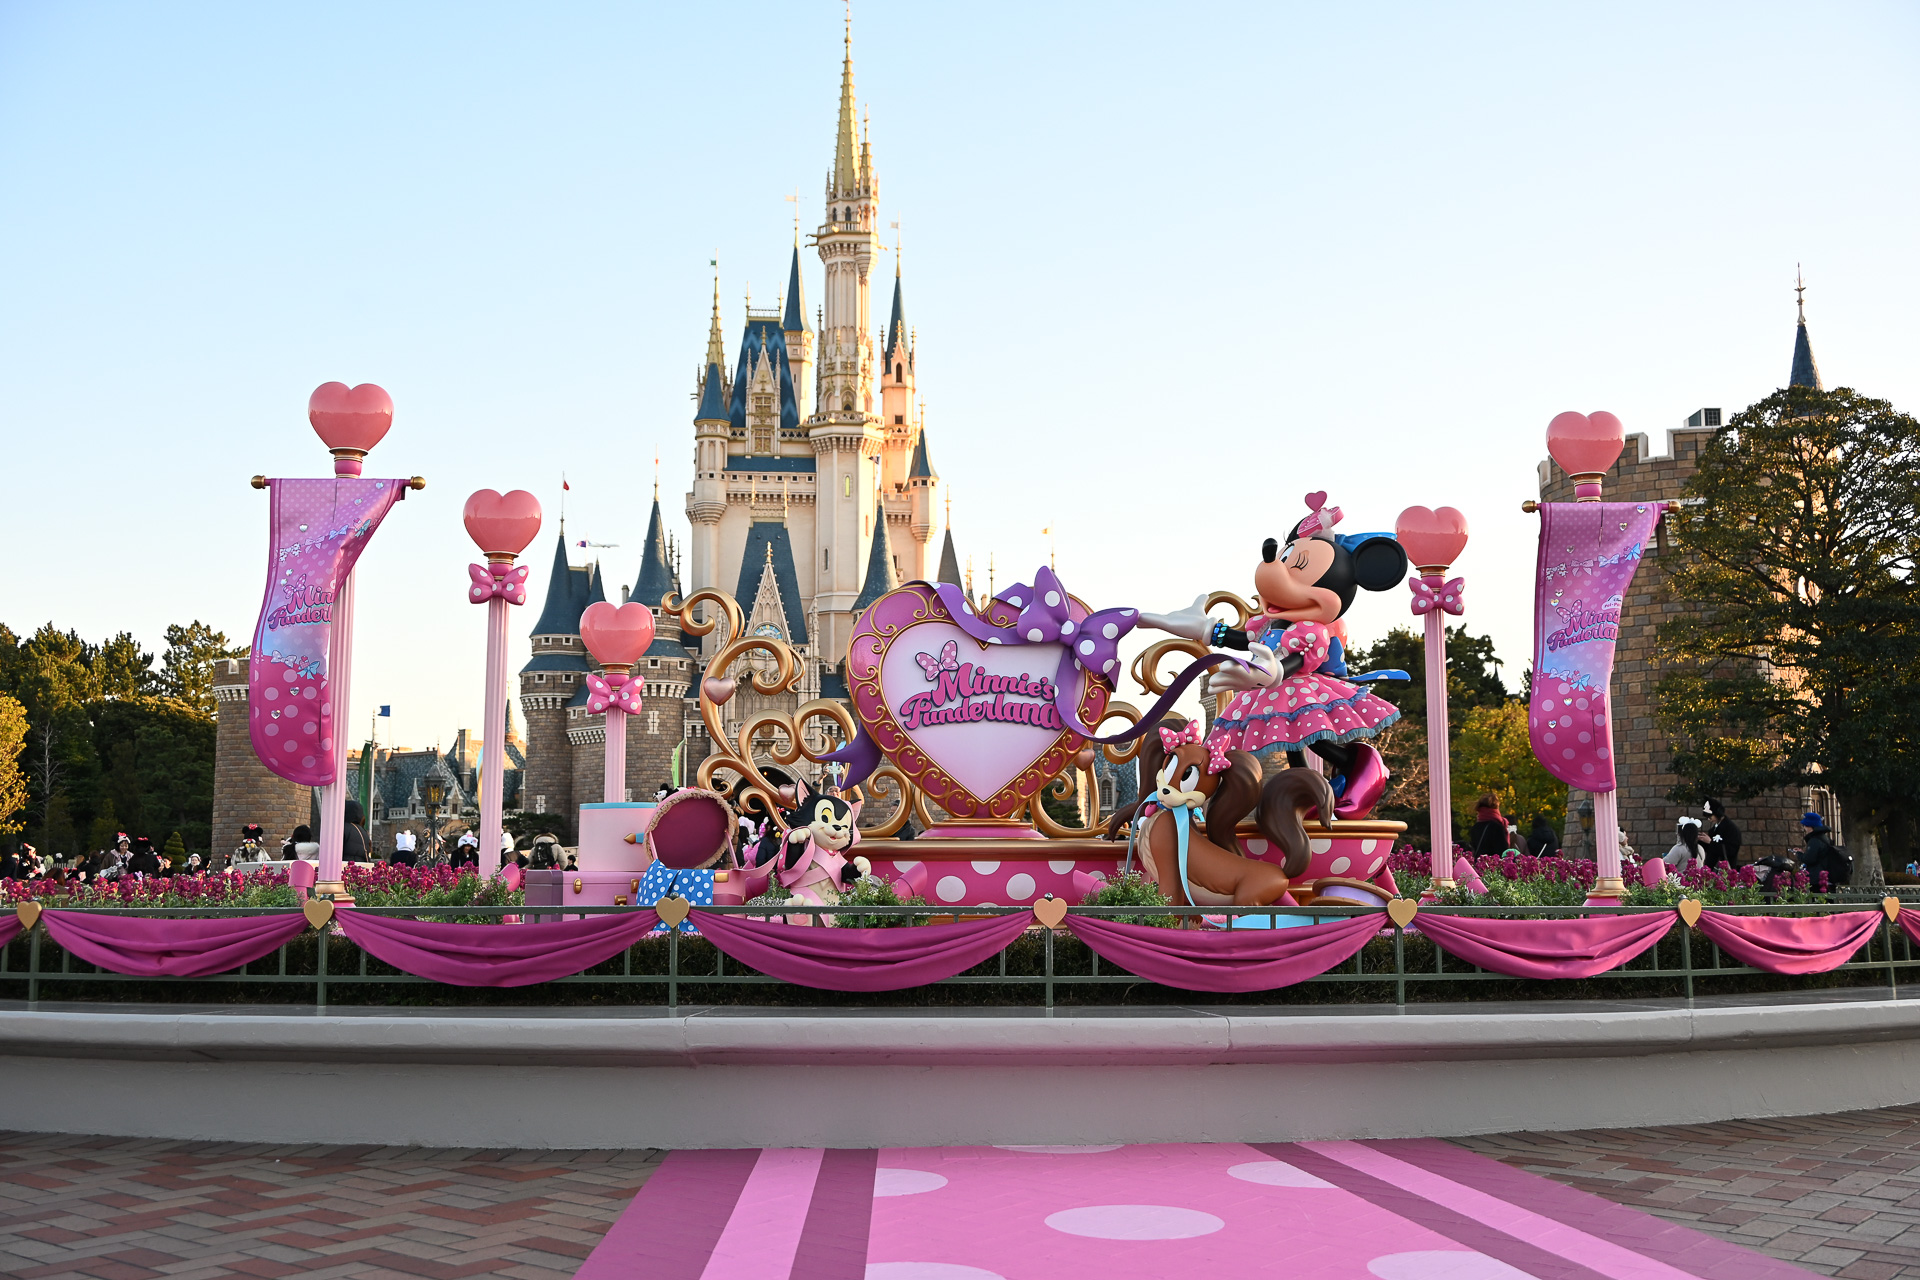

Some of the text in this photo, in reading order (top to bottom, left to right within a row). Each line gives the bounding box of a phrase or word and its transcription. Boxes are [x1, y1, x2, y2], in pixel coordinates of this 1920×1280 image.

[286, 585, 334, 614] Min
[1547, 623, 1617, 651] Funderla
[932, 662, 1054, 707] Minnie's
[900, 693, 1064, 731] Funderland
